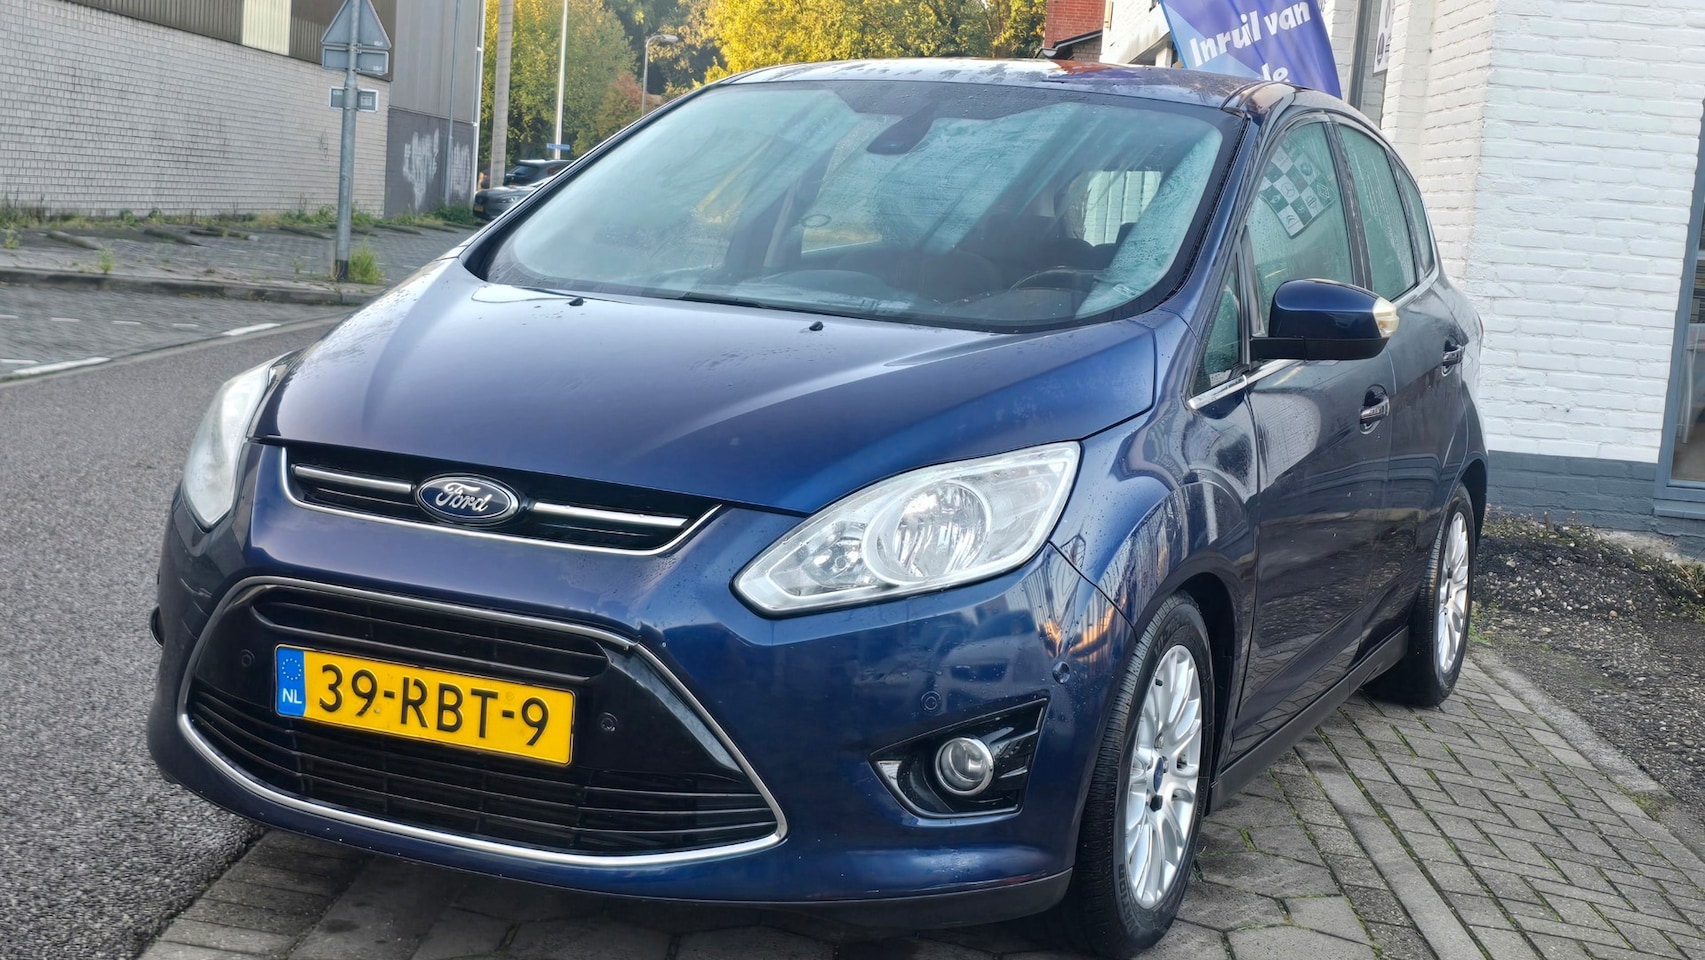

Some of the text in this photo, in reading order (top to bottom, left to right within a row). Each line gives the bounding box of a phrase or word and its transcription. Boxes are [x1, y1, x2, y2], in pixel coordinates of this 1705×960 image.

[1190, 2, 1311, 67] Inruil van
[435, 481, 493, 513] Ford
[282, 687, 303, 704] NL
[318, 663, 550, 747] 39-RBT-9
